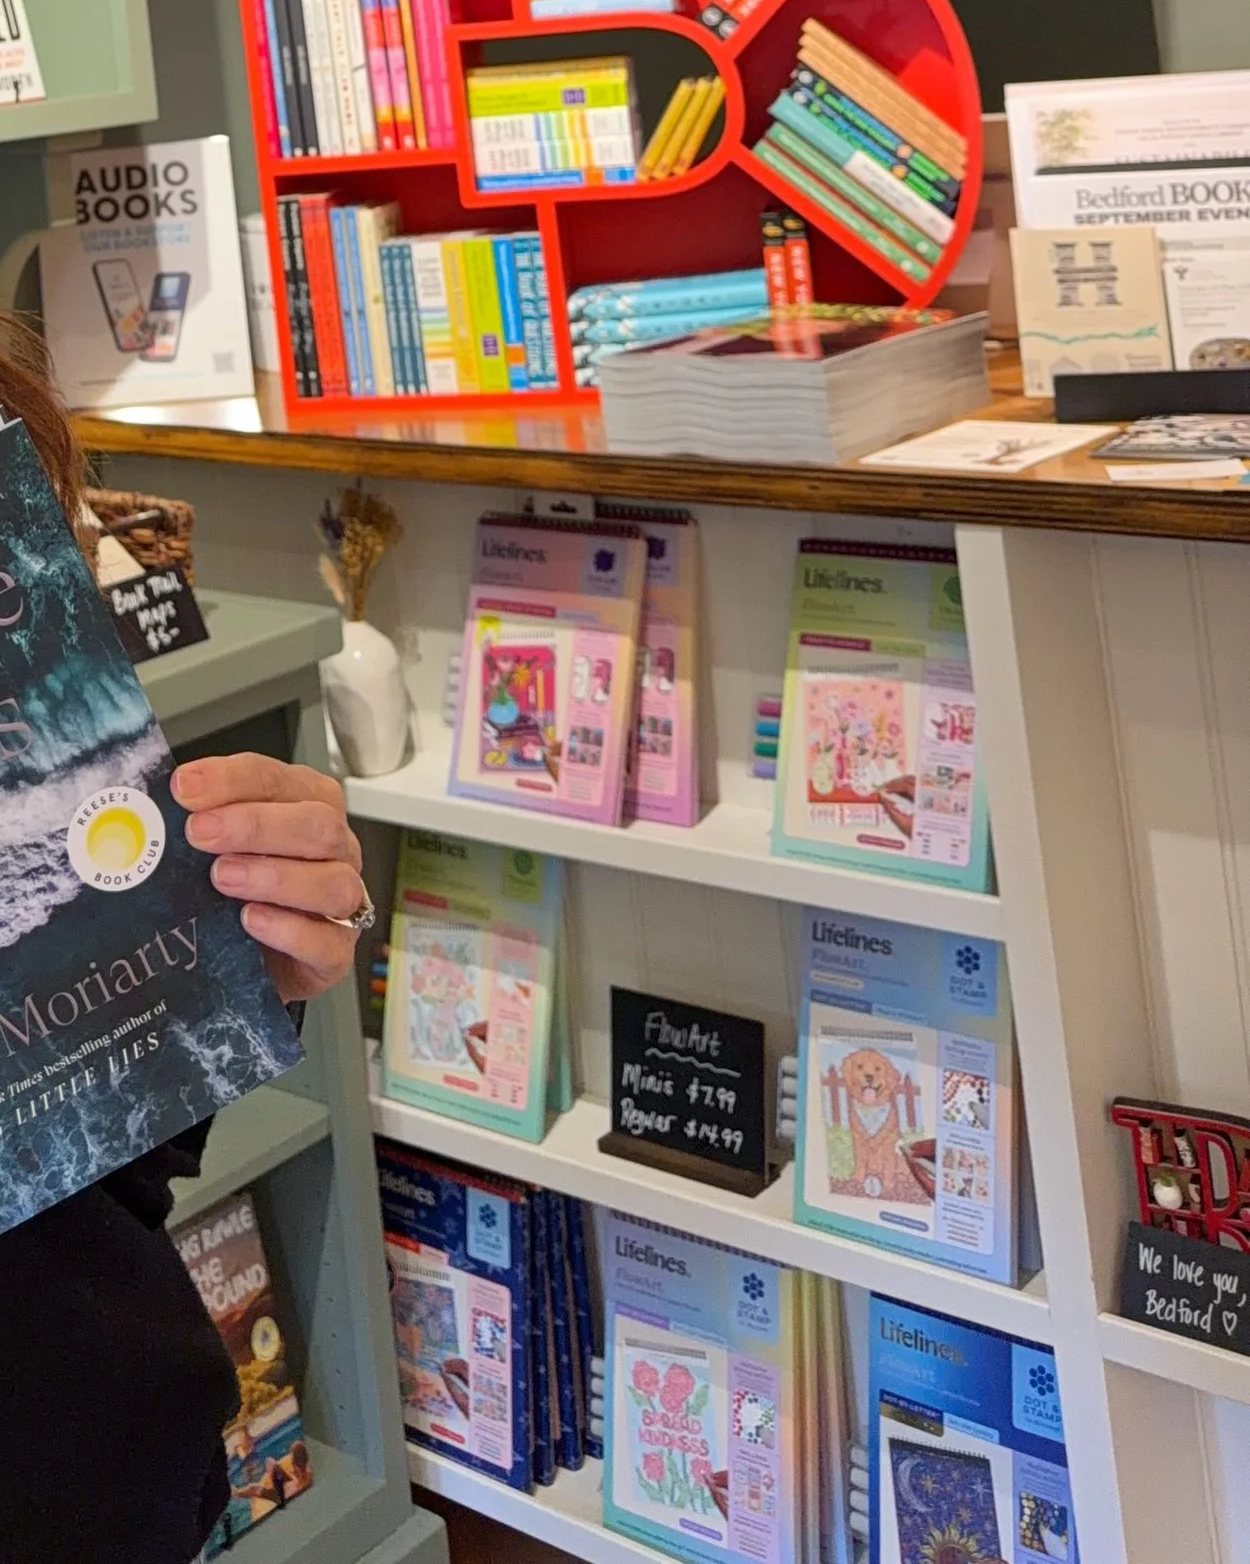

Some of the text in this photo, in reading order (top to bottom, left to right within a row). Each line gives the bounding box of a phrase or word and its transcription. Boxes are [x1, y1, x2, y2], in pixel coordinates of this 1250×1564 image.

[75, 161, 189, 196] AUDIO
[1075, 184, 1166, 209] Bedford
[76, 189, 198, 226] BOOKS
[1074, 208, 1192, 225] SEPTEMBER
[804, 569, 886, 594] Lifelines
[77, 792, 131, 827] REESE'S
[94, 838, 162, 889] BOOK CLUB
[811, 921, 893, 956] Lifelines
[6, 1071, 44, 1099] Times
[43, 1033, 114, 1082] bestselling
[111, 1007, 154, 1041] author
[152, 998, 169, 1018] of
[15, 1069, 99, 1126] LITTLE
[107, 1030, 162, 1075] LIES
[686, 1077, 736, 1115] $7.99
[620, 1097, 744, 1154] Regular $14.99
[615, 1235, 688, 1277] Lifelines
[1138, 1243, 1247, 1308] We love you,
[1145, 1289, 1213, 1334] Bedford
[879, 1316, 965, 1367] Lifelines
[1024, 1396, 1048, 1410] DOT
